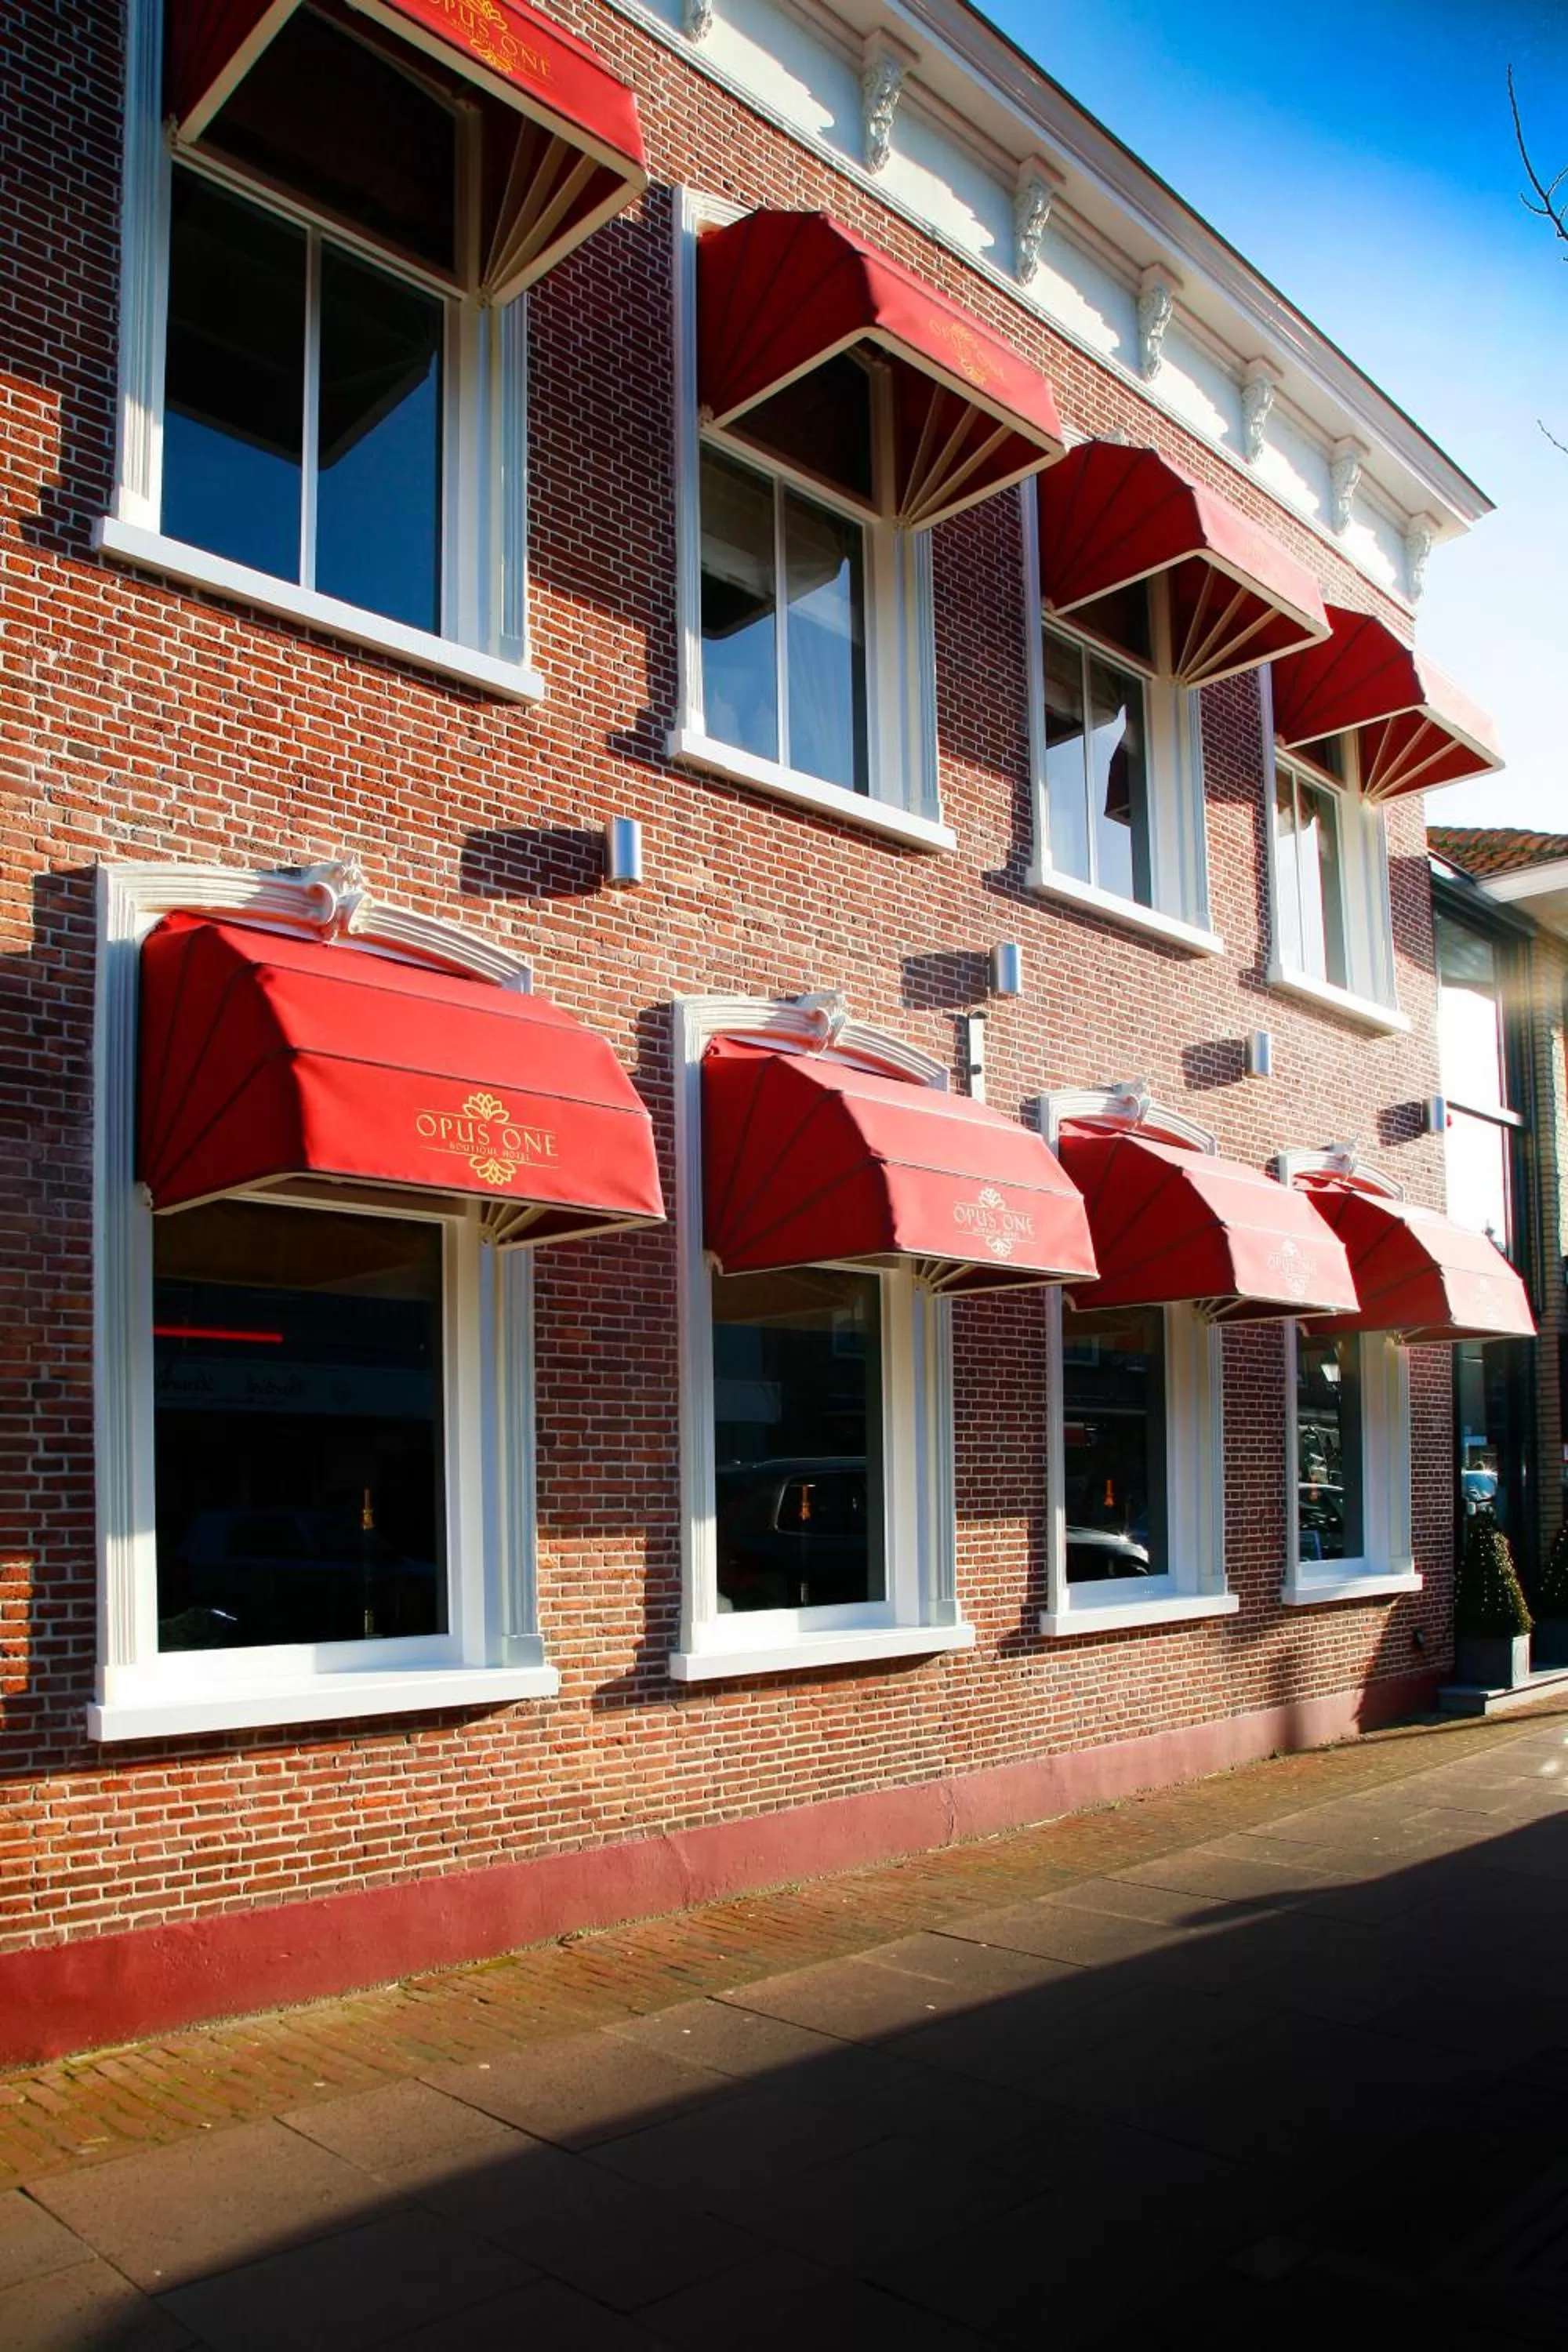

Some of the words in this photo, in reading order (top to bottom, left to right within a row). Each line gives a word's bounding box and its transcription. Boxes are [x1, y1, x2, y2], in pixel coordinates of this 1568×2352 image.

[430, 0, 489, 38] PUS
[416, 1114, 490, 1145] OPUS
[503, 1128, 559, 1156] ONE
[953, 1206, 996, 1230] OPUS
[1003, 1213, 1034, 1236] ONE
